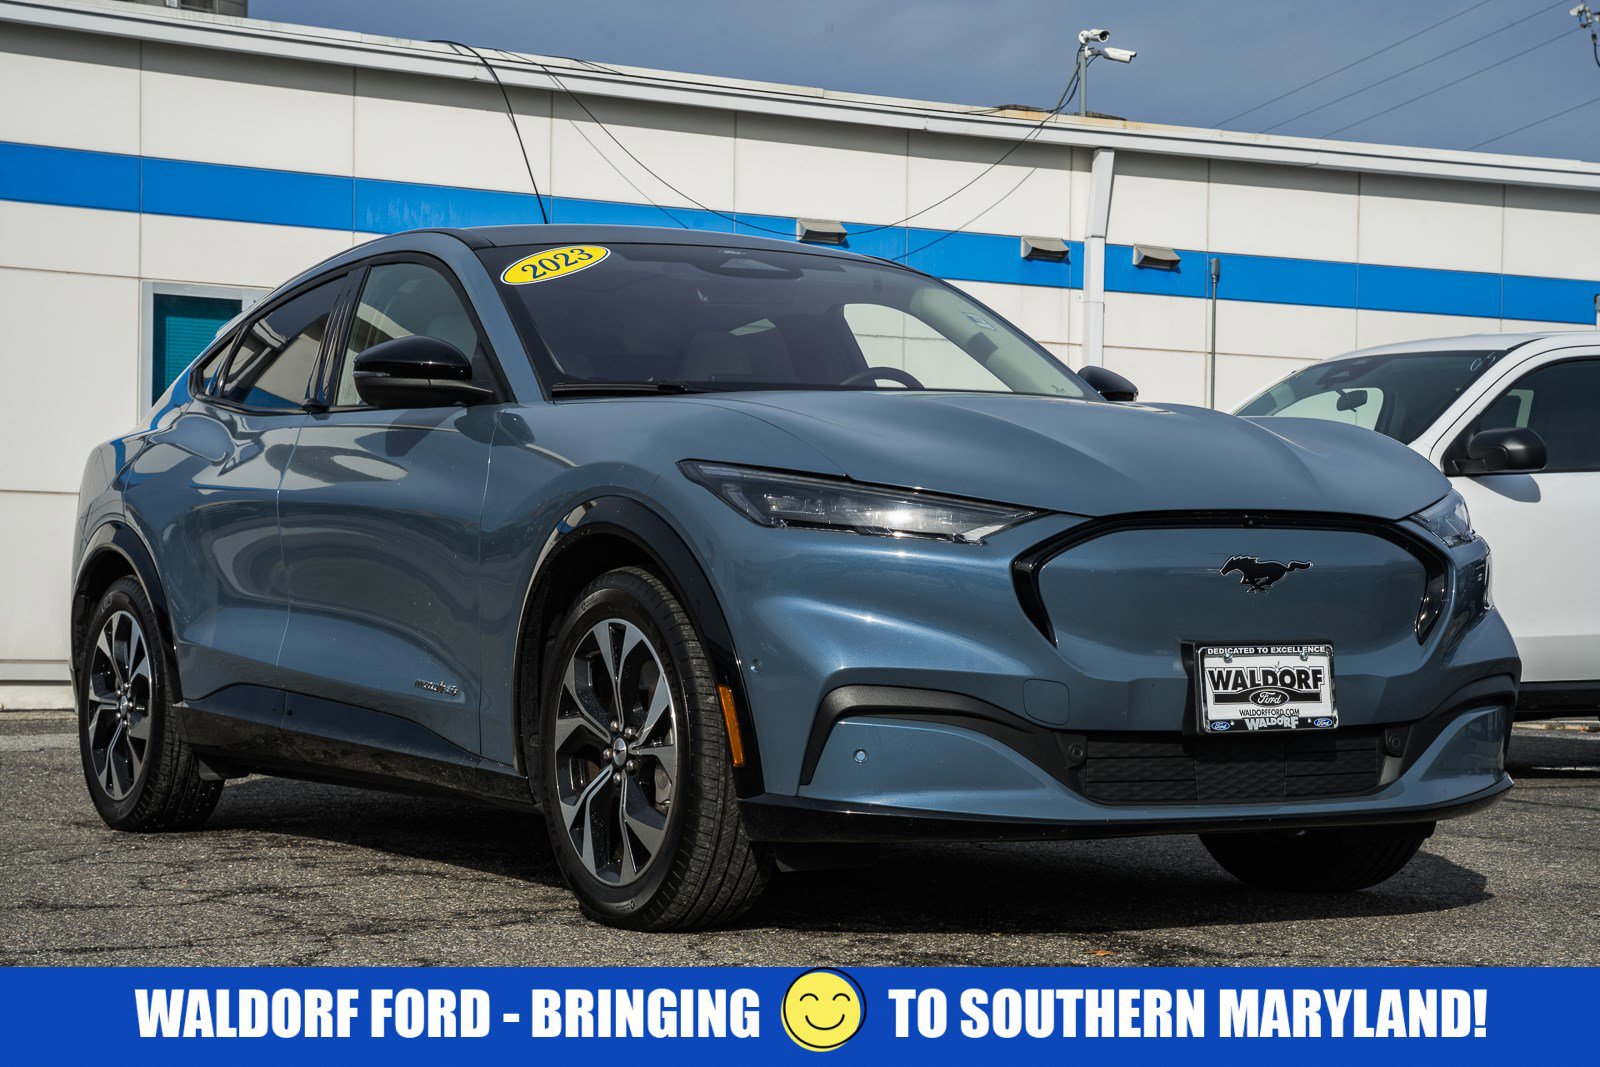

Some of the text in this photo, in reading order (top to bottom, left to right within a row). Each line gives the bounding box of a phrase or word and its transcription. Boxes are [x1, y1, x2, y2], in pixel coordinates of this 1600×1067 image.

[521, 248, 593, 279] 2023
[1207, 647, 1255, 655] DEDICATED
[1270, 646, 1326, 654] EXCELLENCE
[1206, 666, 1325, 692] WALDORF
[1257, 691, 1282, 704] Ford
[1239, 708, 1300, 717] WALDORFFORD.COM
[1244, 715, 1299, 730] WALDORF
